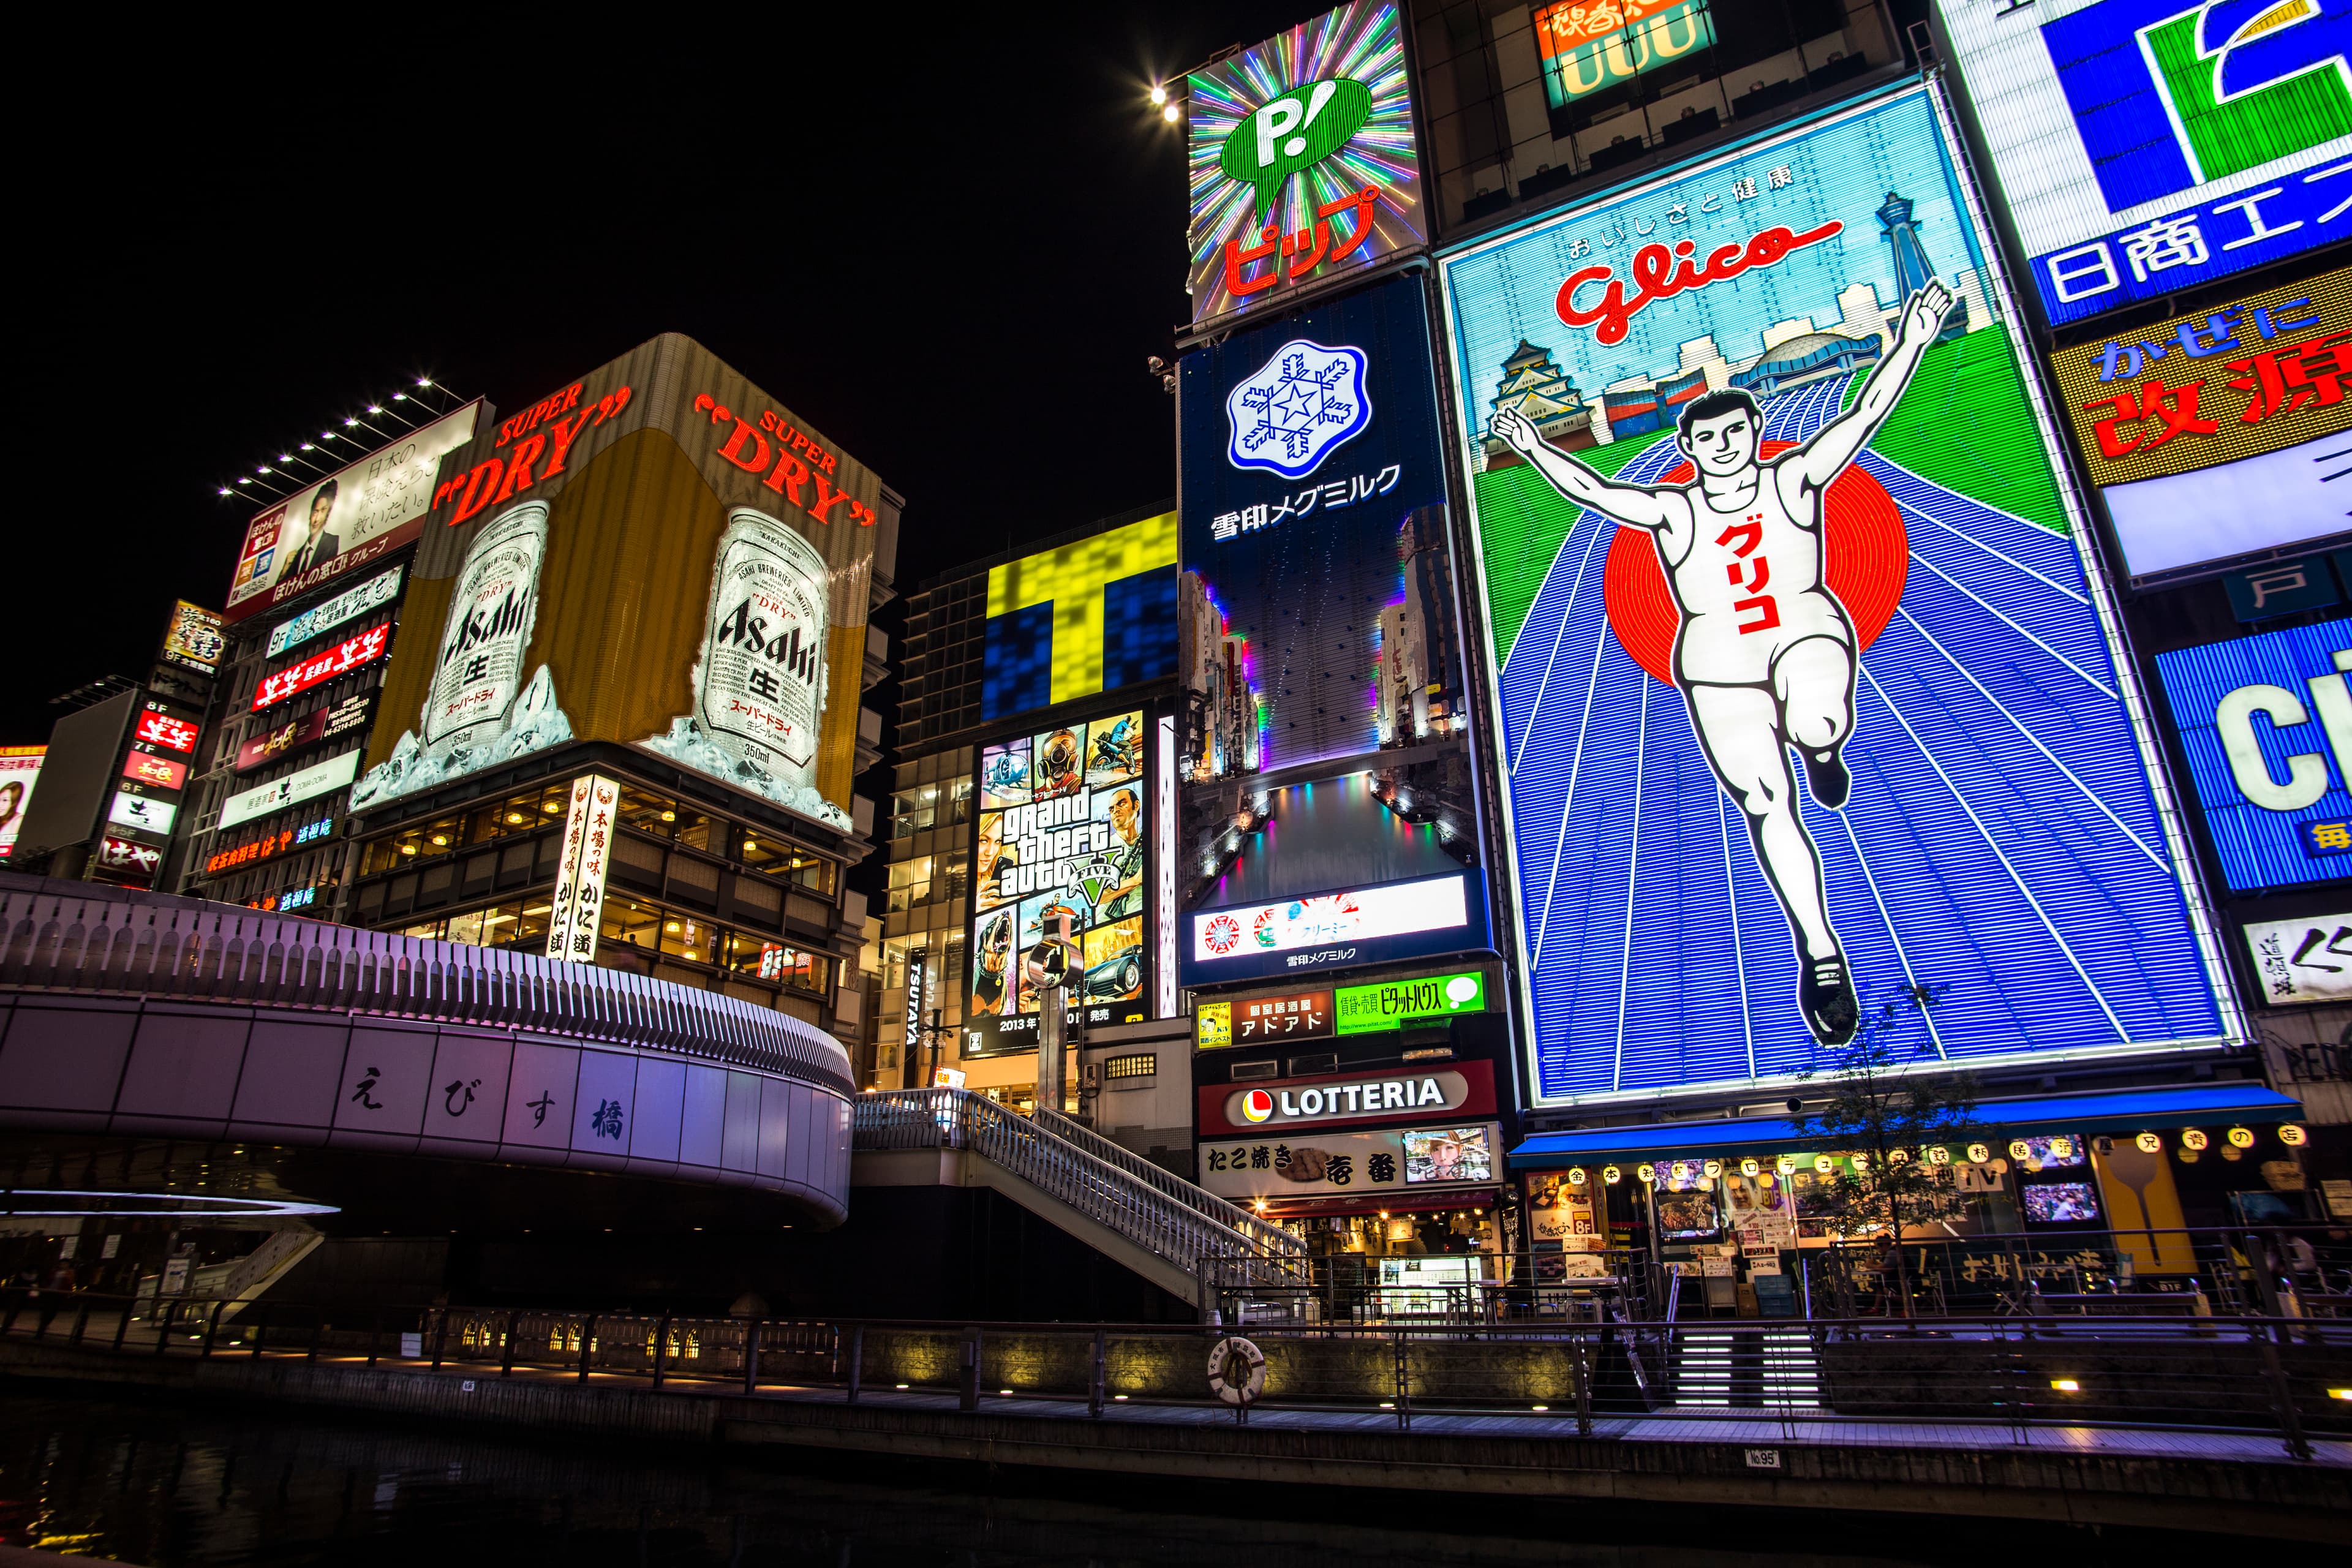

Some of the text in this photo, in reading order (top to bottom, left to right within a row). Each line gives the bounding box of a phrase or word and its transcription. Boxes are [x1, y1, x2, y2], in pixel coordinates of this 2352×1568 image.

[1543, 0, 1660, 37] 線香
[1569, 164, 1795, 260] おいしさと健康
[1226, 185, 1381, 296] ピップ
[2091, 297, 2320, 382] かぜに
[2084, 329, 2352, 458] 改源
[495, 383, 582, 448] SUPER
[760, 410, 837, 475] SUPER
[368, 444, 416, 481] 日本の
[1211, 464, 1401, 543] 雪印メグミルク
[738, 564, 810, 617] ASAHI BREWERIES LIMITED
[1714, 513, 1781, 635] グリコ
[271, 632, 287, 651] 9F
[443, 586, 529, 666] Asahi
[718, 597, 816, 687] Asahi
[464, 655, 489, 686] 生
[750, 668, 780, 704] 生
[146, 701, 168, 712] 8F
[446, 687, 496, 717] スーパードライ
[730, 699, 792, 736] スーパードライ
[134, 741, 156, 753] 7F
[452, 730, 473, 747] 350ml
[744, 743, 770, 764] 350ml
[121, 782, 143, 793] 6F
[102, 840, 160, 872] はや
[1017, 822, 1110, 865] theft
[549, 807, 583, 960] 本場の味 かに道
[570, 810, 608, 965] 本場の味 かに道
[1001, 858, 1069, 897] auto
[1287, 948, 1356, 967] 雪印メグミルク
[907, 963, 921, 1046] TSUTAYA
[1250, 999, 1311, 1017] 個室居酒屋
[1381, 982, 1442, 1016] ピタットハウス
[1000, 1009, 1110, 1032] 2013 年 発売
[1242, 1011, 1322, 1037] アドアド
[1340, 1019, 1392, 1030] http://www.pitat.com/
[351, 1067, 624, 1140] えびす橋
[1280, 1077, 1445, 1117] LOTTERIA
[1207, 1143, 1293, 1172] たこ焼き
[1575, 1220, 1591, 1235] 8F
[1751, 1452, 1774, 1465] No.95
